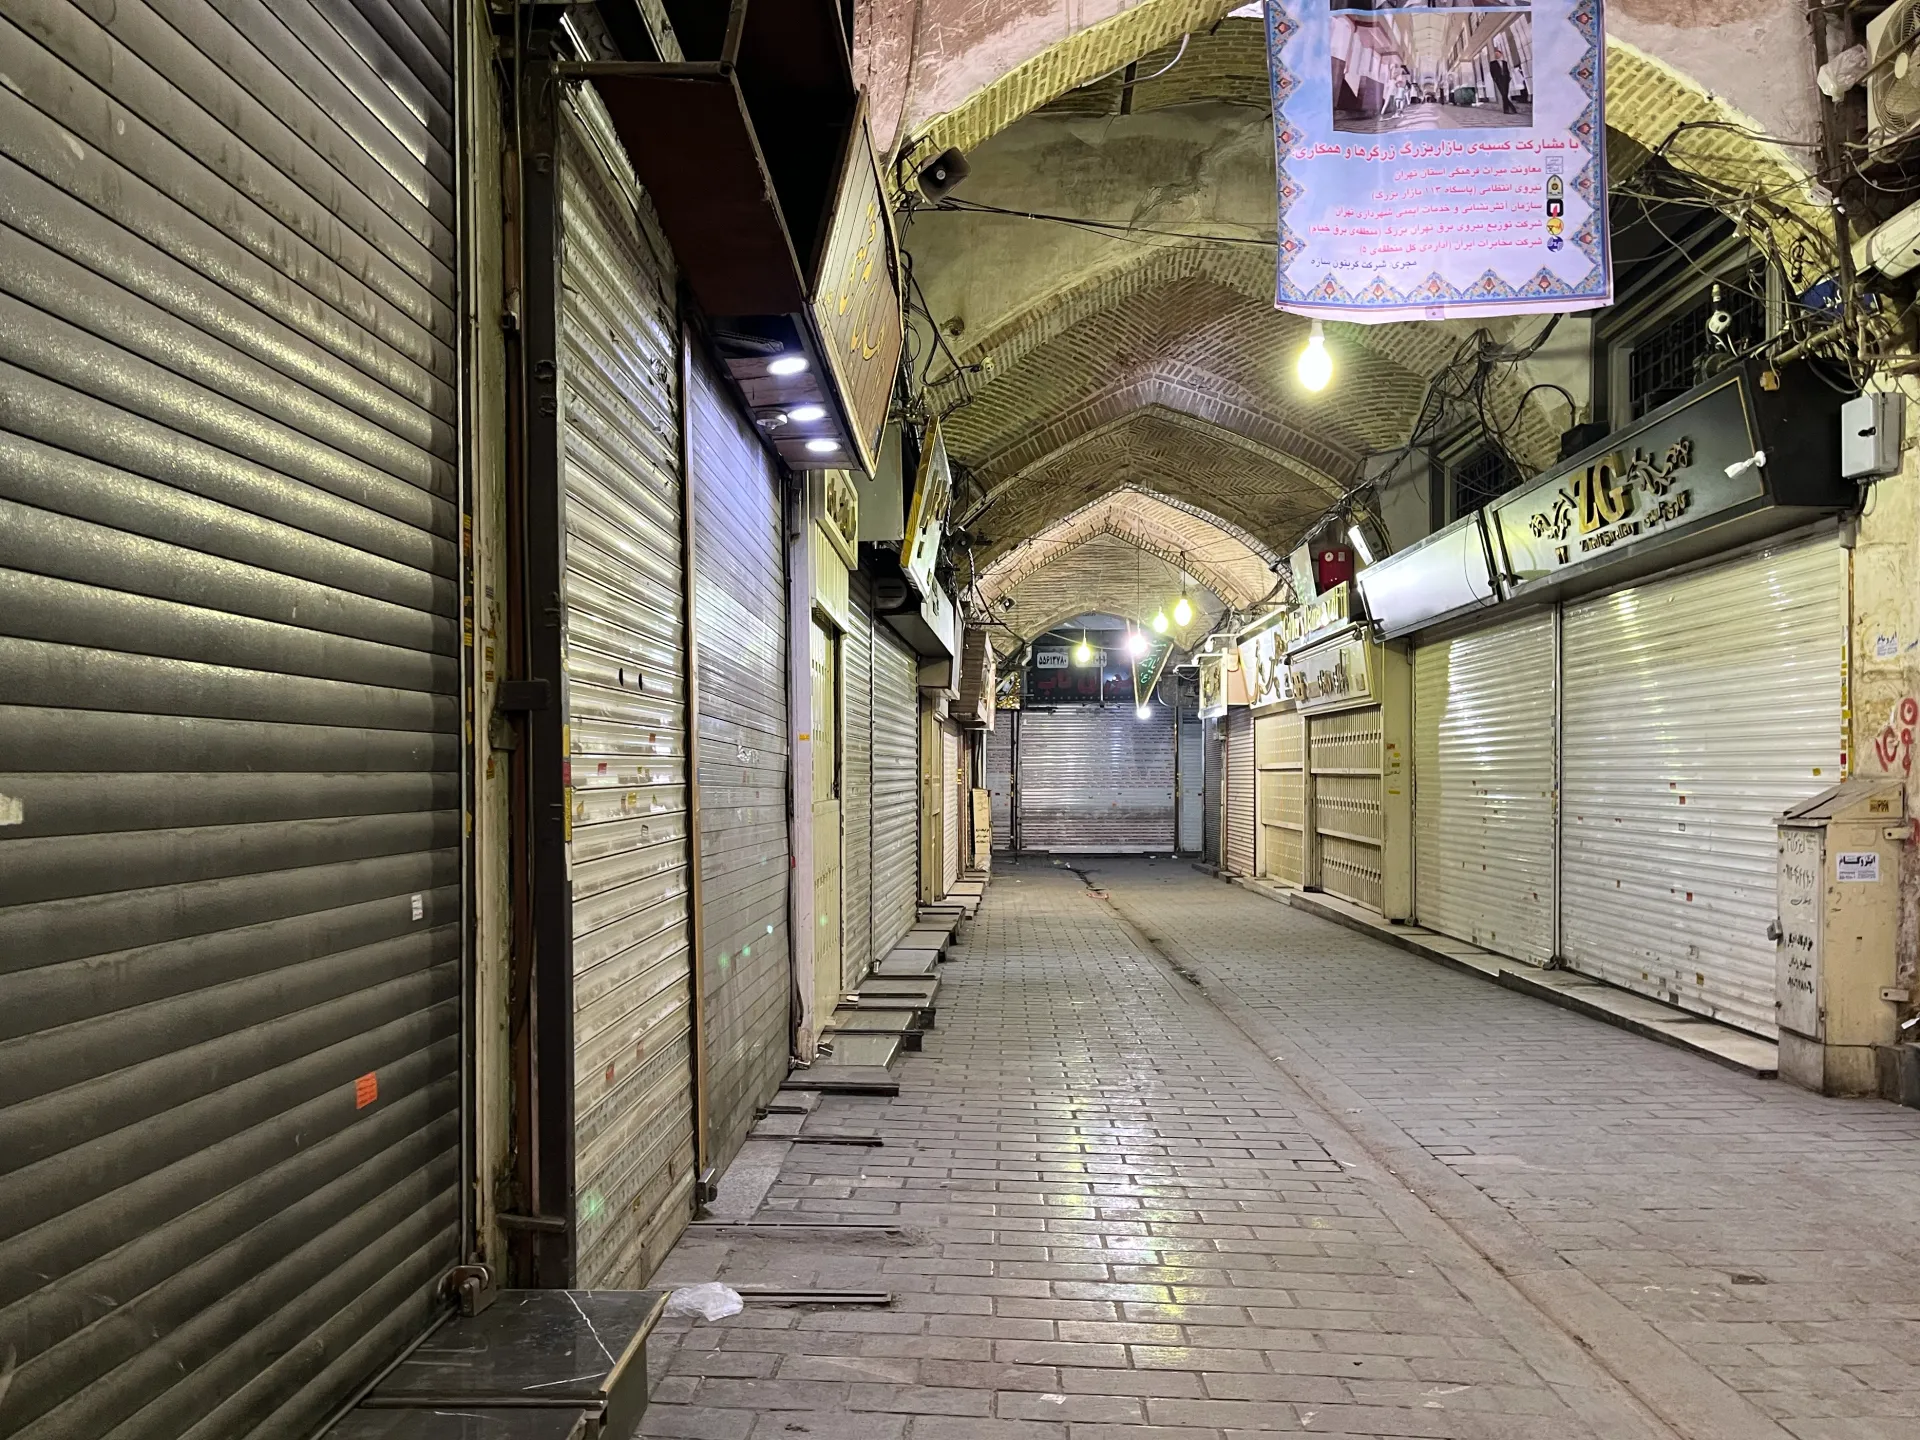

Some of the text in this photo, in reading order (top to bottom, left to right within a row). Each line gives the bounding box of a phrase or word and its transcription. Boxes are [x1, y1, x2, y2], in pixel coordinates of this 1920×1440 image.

[1515, 138, 1565, 154] مشارکت
[1569, 138, 1579, 154] با
[1345, 147, 1352, 159] و
[1354, 144, 1396, 161] زرگرها
[1394, 166, 1542, 181] معاونت میراث فرهنگی استان تهران
[1401, 187, 1422, 200] بازار
[1480, 183, 1513, 196] انتظامی
[1515, 185, 1542, 195] نیروی
[1335, 206, 1355, 218] تهران
[1395, 206, 1419, 218] ایمنی
[1422, 203, 1450, 214] خدمات
[1453, 205, 1459, 214] و
[1511, 201, 1543, 213] سازمان
[1356, 208, 1393, 220] شهرداری
[1410, 223, 1434, 236] تهران
[1436, 224, 1454, 234] برق
[1457, 222, 1484, 232] نیروی
[1486, 223, 1513, 233] توزیع
[1515, 219, 1543, 230] شرکت
[1333, 226, 1347, 237] برق
[1384, 226, 1408, 237] بزرگ
[1405, 242, 1417, 253] کل
[1454, 240, 1475, 252] ایران
[1477, 239, 1513, 250] مخابرات
[1515, 237, 1543, 249] شرکت
[1361, 260, 1387, 272] شرکت
